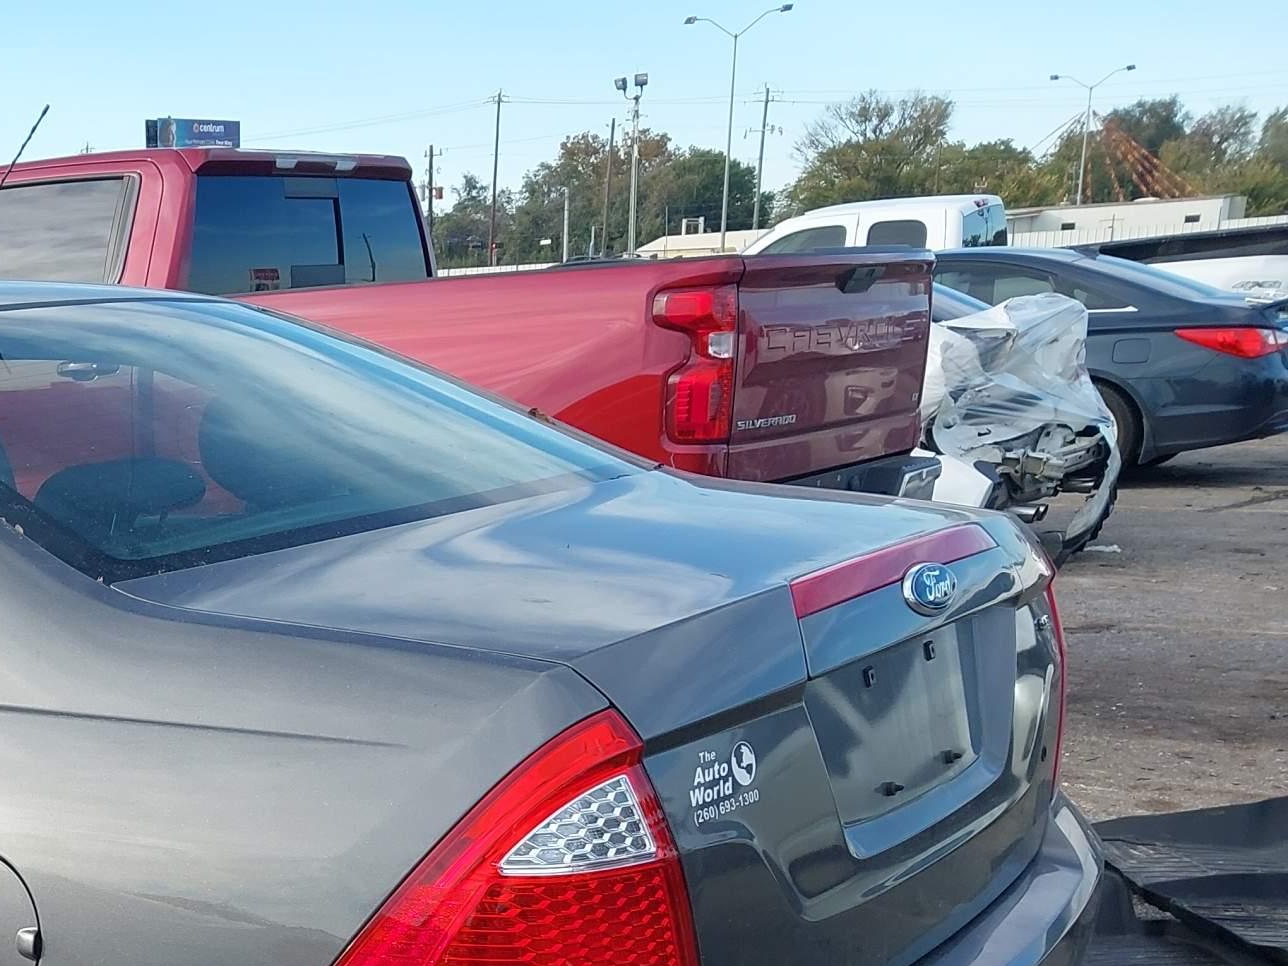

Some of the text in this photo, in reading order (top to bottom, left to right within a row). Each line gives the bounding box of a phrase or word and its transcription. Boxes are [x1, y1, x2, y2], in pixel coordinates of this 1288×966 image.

[199, 124, 225, 133] centrum
[737, 414, 797, 431] SILVERADO
[923, 570, 951, 600] Ford
[698, 751, 716, 763] The
[694, 761, 728, 786] Auto
[690, 777, 732, 807] World
[694, 789, 759, 827] (260) 693-1300
